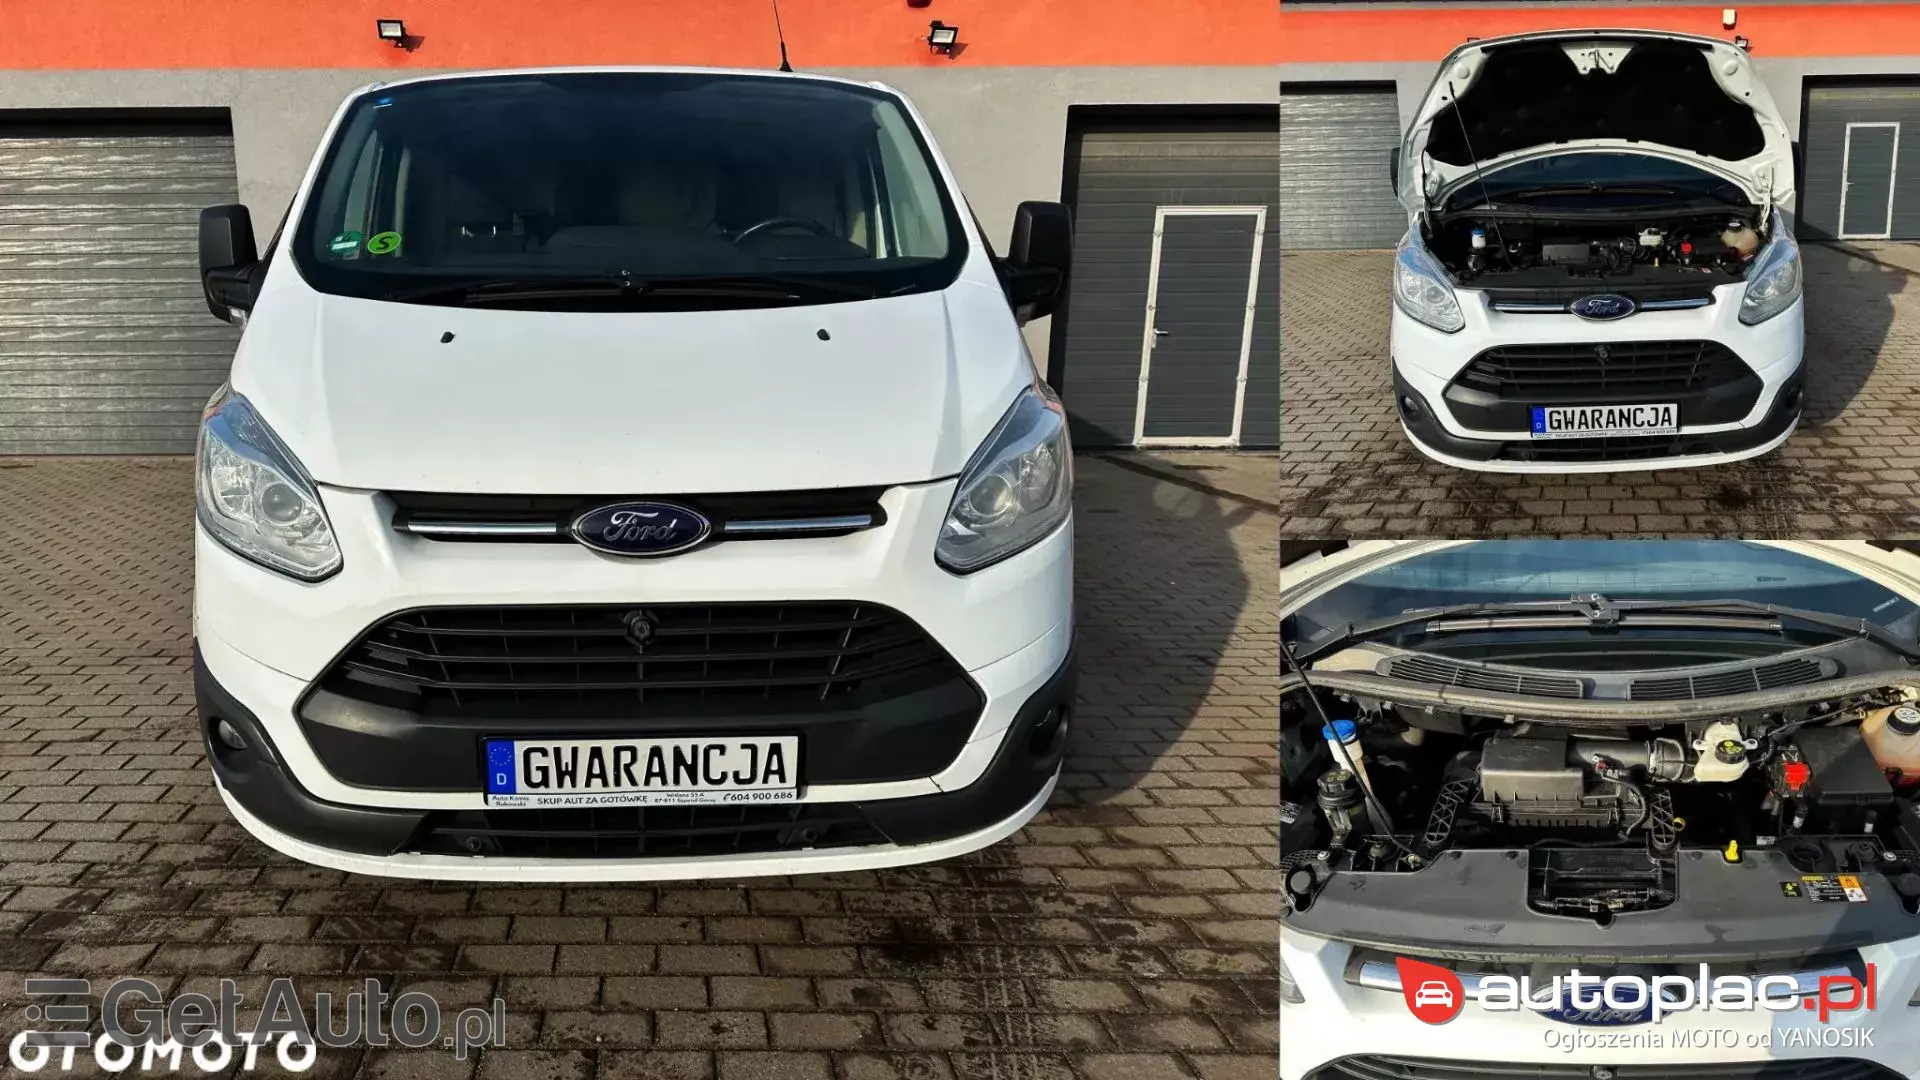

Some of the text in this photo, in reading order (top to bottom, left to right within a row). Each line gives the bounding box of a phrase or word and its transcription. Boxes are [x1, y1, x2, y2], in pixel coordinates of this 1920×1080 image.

[376, 235, 394, 250] S
[1584, 299, 1620, 314] Ford
[1549, 406, 1672, 430] GWARANCJA
[603, 510, 678, 542] Ford
[522, 742, 787, 789] GWARANCJA
[496, 773, 507, 786] D
[537, 797, 562, 805] SKUP
[585, 796, 598, 804] ZA
[600, 794, 647, 804] GOTÓWKĘ
[730, 791, 793, 801] 604 900 686
